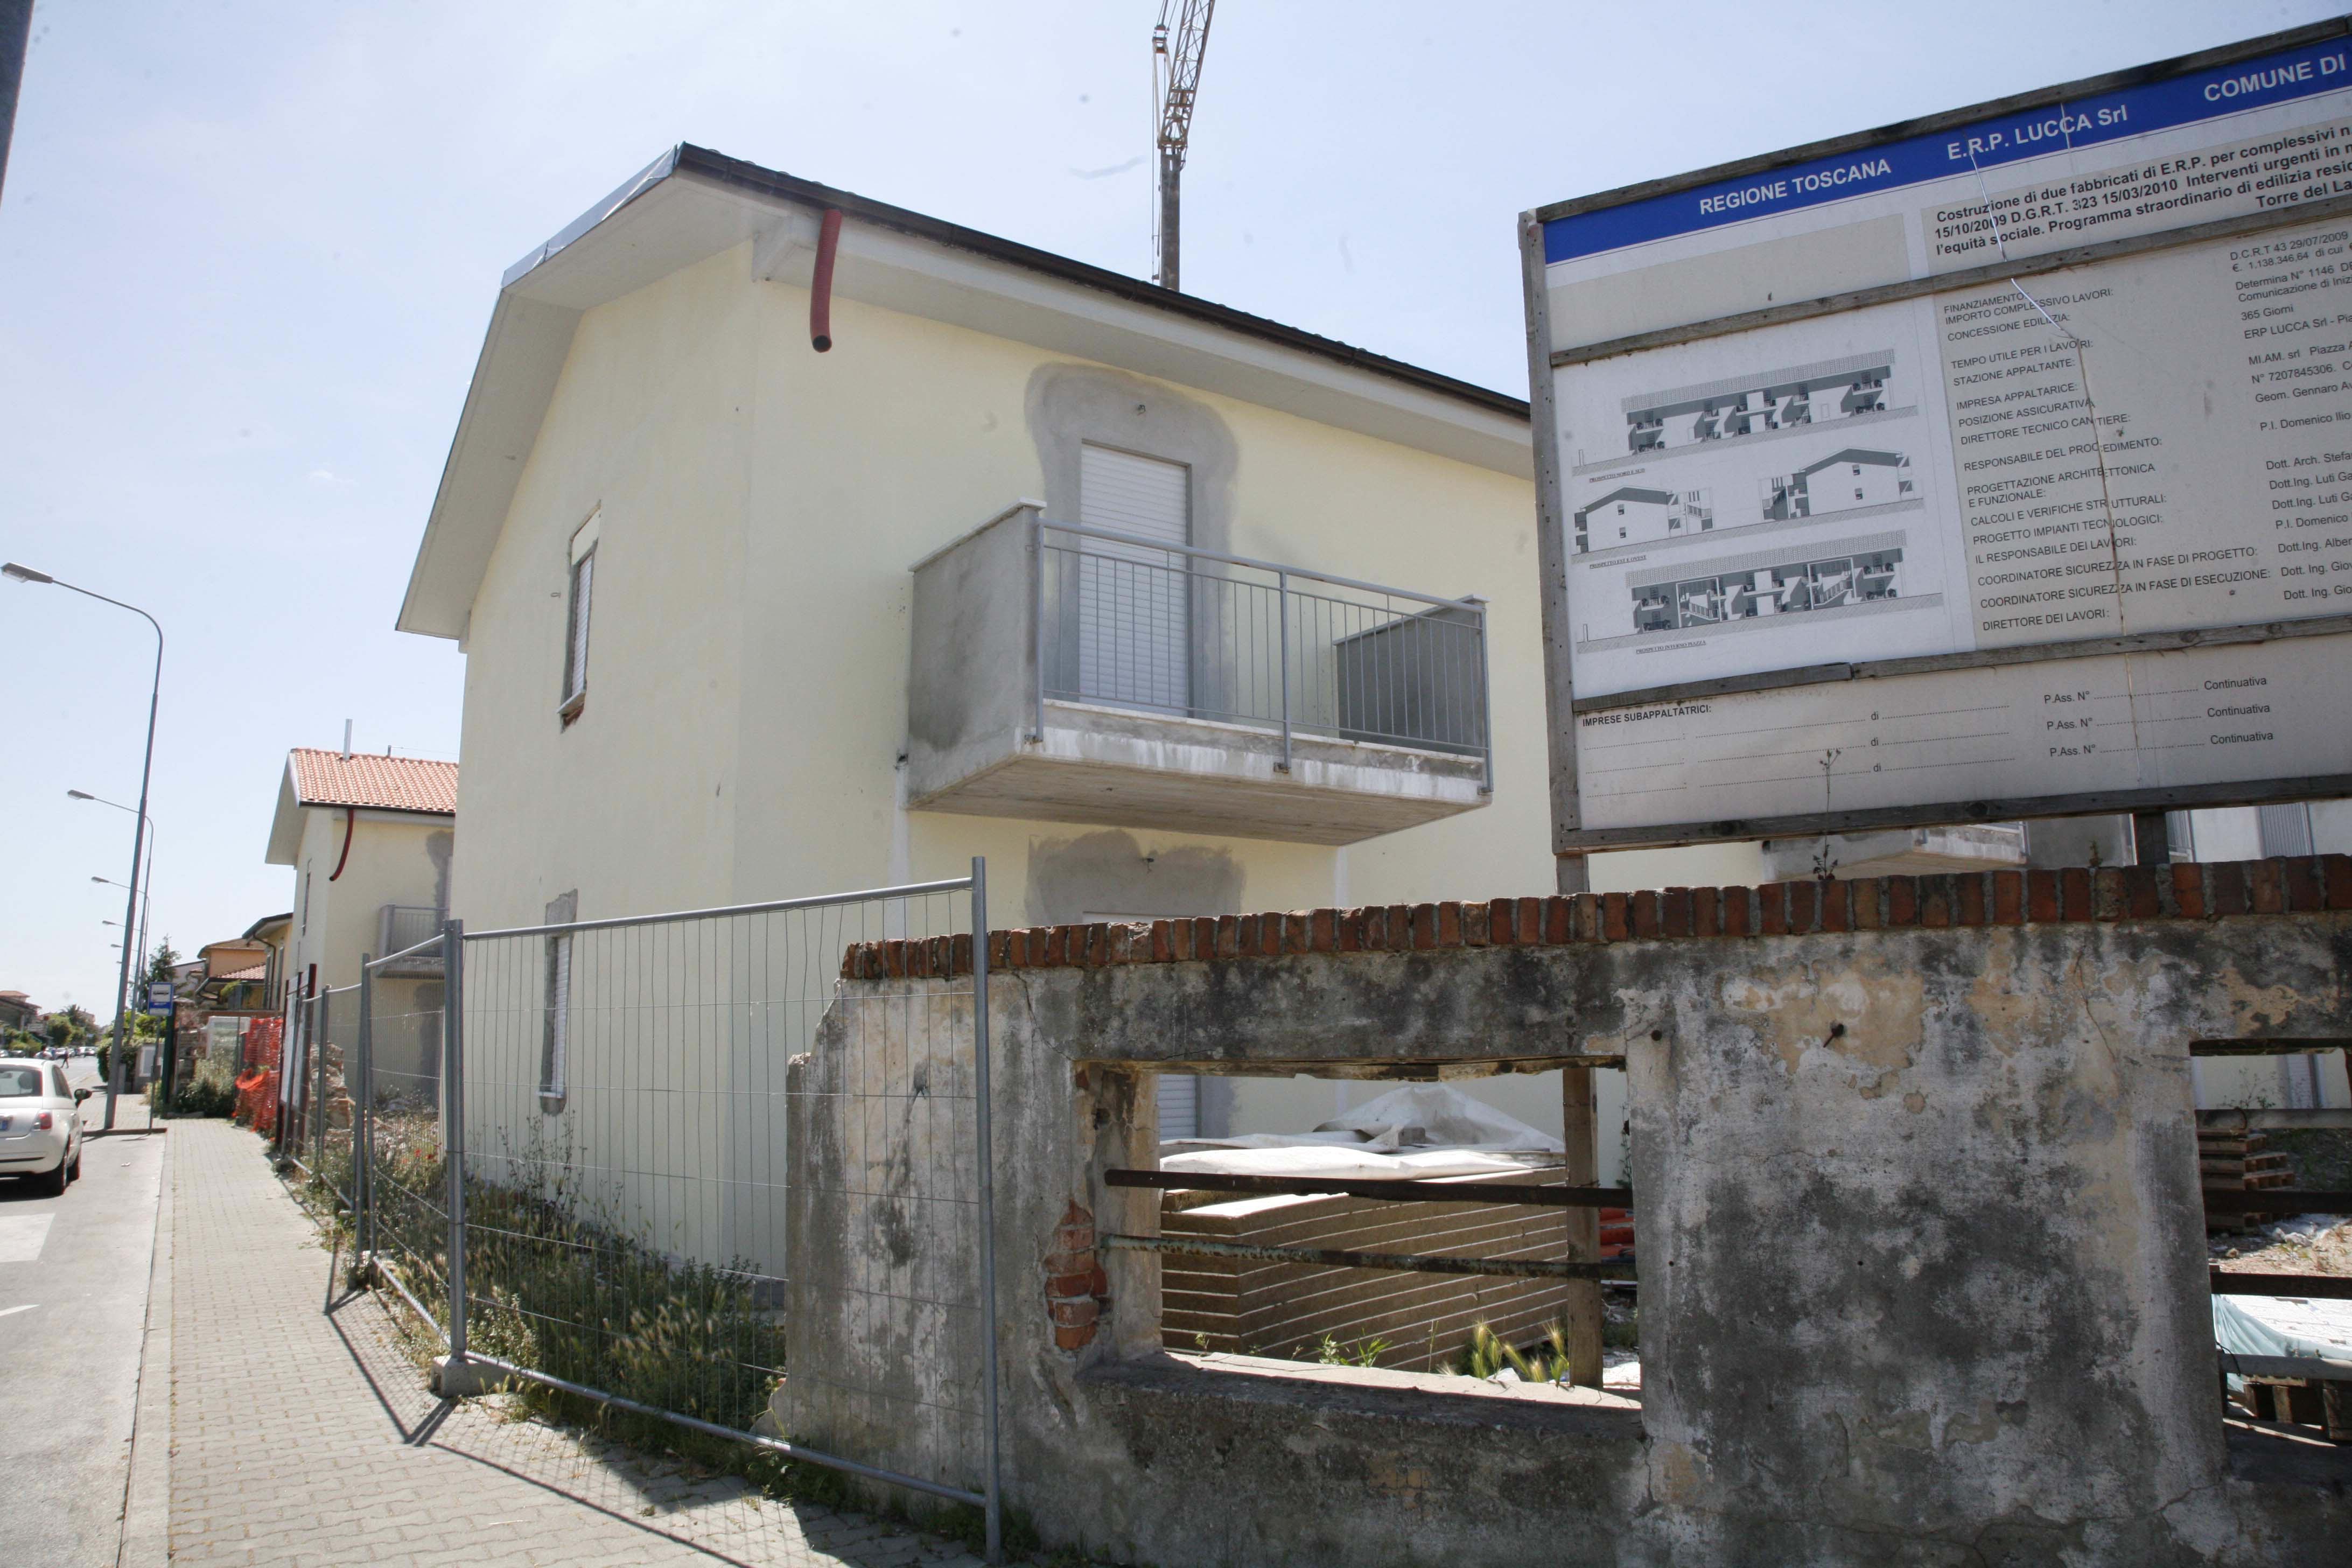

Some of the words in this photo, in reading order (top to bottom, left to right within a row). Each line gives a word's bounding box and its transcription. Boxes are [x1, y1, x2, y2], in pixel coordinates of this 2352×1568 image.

[2204, 61, 2313, 101] COMUNE
[2320, 53, 2346, 75] DI
[1947, 133, 2010, 160] E.R.P.
[2015, 114, 2092, 145] LUCCA
[2097, 104, 2128, 125] Srl
[1937, 198, 2020, 222] Costruzione
[2024, 191, 2036, 204] di
[2041, 184, 2066, 200] due
[2070, 170, 2138, 194] fabbricati
[2143, 166, 2156, 179] di
[2160, 156, 2206, 176] E.R.P.
[2211, 150, 2235, 167] per
[2240, 127, 2334, 158] complessivi
[1699, 181, 1788, 215] REGIONE
[1792, 159, 1892, 194] TOSCANA
[1935, 215, 2006, 239] 15/10/2009
[2011, 202, 2068, 223] D.G.R.T.
[2073, 197, 2097, 211] 323
[2102, 179, 2178, 205] 15/03/2010
[2186, 162, 2258, 187] Interventi
[2264, 149, 2320, 171] urgenti
[2325, 146, 2340, 158] in
[2256, 192, 2299, 208] Torre
[2304, 183, 2328, 199] del
[1990, 226, 2045, 244] sociale.
[2049, 208, 2132, 232] Programma
[2136, 187, 2232, 215] straordinario
[2237, 182, 2251, 195] di
[2256, 170, 2311, 190] edilizia
[2230, 246, 2270, 261] D.C.R.T
[2274, 243, 2287, 252] 43
[2290, 231, 2348, 250] 29/07/2009
[2249, 251, 2309, 269] 1.138.346,64
[2315, 248, 2325, 257] di
[2328, 245, 2343, 254] cui
[2235, 275, 2287, 290] Determina
[2291, 270, 2304, 281] N°
[2309, 265, 2334, 277] 1146
[2238, 282, 2317, 302] Comunicazione
[2320, 279, 2329, 289] di
[1945, 309, 1991, 325] IMPORTO
[1994, 296, 2070, 316] COMPLESSIVO
[2073, 288, 2113, 303] LAVORI:
[2241, 310, 2260, 320] 365
[2263, 304, 2293, 317] Giorni
[1948, 321, 2020, 341] CONCESSIONE
[2244, 327, 2267, 339] ERP
[2270, 321, 2310, 335] LUCCA
[2313, 318, 2327, 327] Srl
[1951, 356, 1986, 369] TEMPO
[1989, 350, 2017, 363] UTILE
[2020, 346, 2041, 358] PER
[2044, 345, 2047, 353] I
[2049, 339, 2093, 352] LAVORI:
[2249, 352, 2284, 365] MI.AM.
[2288, 349, 2300, 359] srl
[2309, 344, 2345, 355] Piazza
[1954, 370, 2003, 386] STAZIONE
[2006, 358, 2075, 376] APPALTANTE:
[2252, 374, 2264, 384] N°
[2269, 363, 2336, 381] 7207845306.
[1956, 395, 2001, 410] IMPRESA
[2004, 382, 2078, 401] APPALTARICE:
[2255, 392, 2290, 402] Geom.
[2292, 384, 2337, 397] Gennaro
[1958, 411, 2013, 427] POSIZIONE
[1961, 428, 2019, 445] DIRETTORE
[2022, 420, 2068, 435] TECNICO
[2071, 414, 2131, 428] CANTIERE:
[2280, 415, 2332, 429] Domenico
[1964, 451, 2042, 471] RESPONSABILE
[2046, 446, 2066, 459] DEL
[2069, 437, 2162, 455] PROCEDIMENTO:
[2266, 460, 2290, 470] Dott.
[2293, 456, 2320, 466] Arch.
[1967, 474, 2055, 495] PROGETTAZIONE
[2058, 463, 2155, 482] ARCHITETTONICA
[2316, 473, 2335, 484] Luti
[1969, 498, 1975, 508] E
[1978, 488, 2046, 505] FUNZIONALE:
[2319, 494, 2337, 504] Luti
[1970, 512, 2015, 526] CALCOLI
[2017, 510, 2025, 520] E
[2026, 502, 2083, 517] VERIFICHE
[2086, 494, 2167, 510] STRUTTURALI:
[2296, 514, 2348, 527] Domenico
[1973, 529, 2031, 544] PROGETTO
[2033, 522, 2080, 536] IMPIANTI
[2083, 514, 2163, 531] TECNOLOGICI:
[1975, 554, 1984, 564] IL
[1986, 544, 2067, 563] RESPONSABILE
[2070, 541, 2088, 551] DEI
[2090, 537, 2137, 549] LAVORI:
[1977, 568, 2062, 586] COORDINATORE
[2066, 559, 2131, 576] SICUREZZA
[2133, 559, 2144, 569] IN
[2146, 555, 2175, 567] FASE
[2178, 554, 2189, 564] DI
[2192, 547, 2258, 562] PROGETTO:
[2281, 566, 2305, 577] Dott.
[2309, 564, 2327, 575] Ing.
[1980, 591, 2066, 609] COORDINATORE
[2068, 583, 2133, 598] SICUREZZA
[2136, 582, 2146, 591] IN
[2150, 578, 2178, 590] FASE
[2181, 577, 2192, 587] DI
[2195, 569, 2271, 586] ESECUZIONE:
[2284, 590, 2307, 600] Dott.
[2312, 588, 2330, 599] Ing.
[1983, 615, 2042, 631] DIRETTORE
[2046, 613, 2064, 624] DEI
[2066, 608, 2109, 622] LAVORI:
[2204, 676, 2267, 691] Continuativa
[2043, 692, 2075, 704] P.Ass.
[2077, 690, 2090, 702] N°
[1583, 715, 1621, 727] IMPRESE
[1623, 705, 1712, 722] SUBAPPALTATRICI:
[1871, 711, 1879, 721] di
[2207, 703, 2270, 718] Continuativa
[2047, 719, 2077, 731] P.Ass.
[2080, 717, 2093, 729] N°
[1871, 737, 1879, 747] di
[2210, 731, 2273, 745] Continuativa
[2049, 746, 2081, 758] P.Ass.
[2083, 744, 2096, 755] N°
[1873, 763, 1881, 773] di
